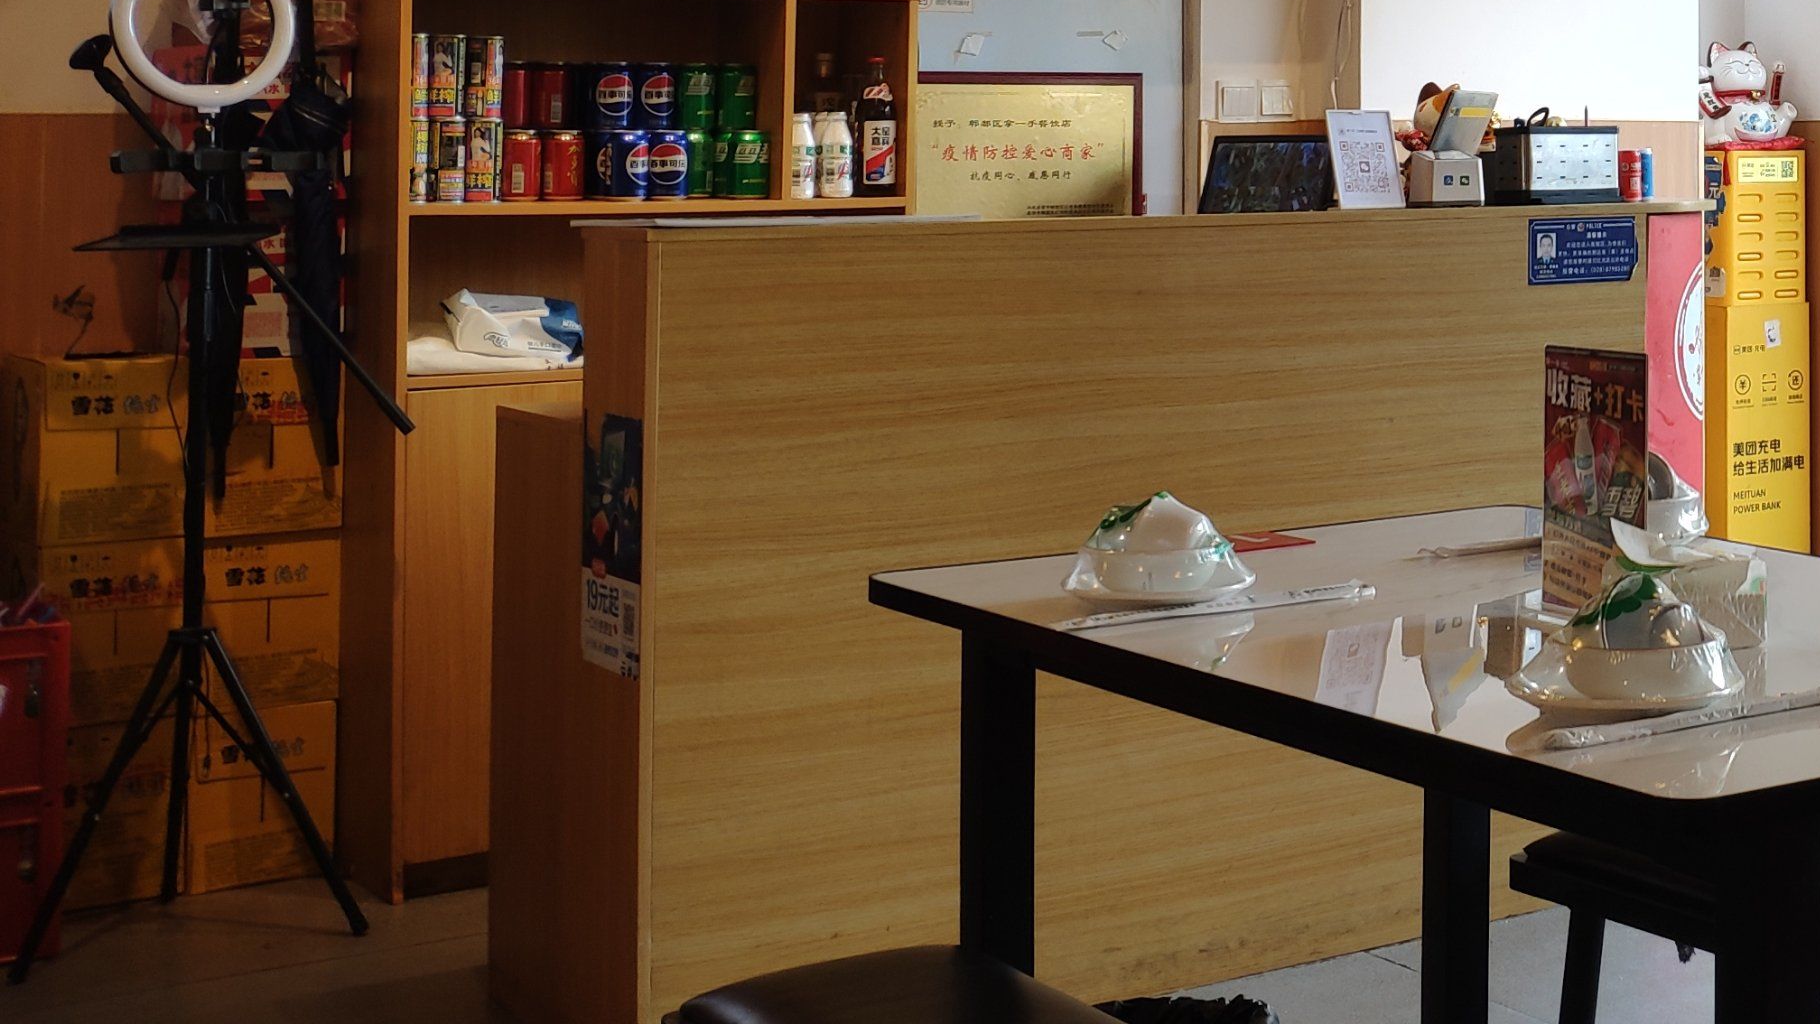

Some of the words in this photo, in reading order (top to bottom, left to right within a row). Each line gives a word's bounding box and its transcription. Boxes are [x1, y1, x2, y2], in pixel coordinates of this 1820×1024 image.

[1732, 438, 1781, 458] 美团充电
[1732, 454, 1805, 477] 给生活加满电
[1733, 488, 1767, 501] MEITUAN
[1733, 502, 1761, 515] POWER
[1761, 501, 1782, 513] BANK
[585, 578, 620, 619] 19元起
